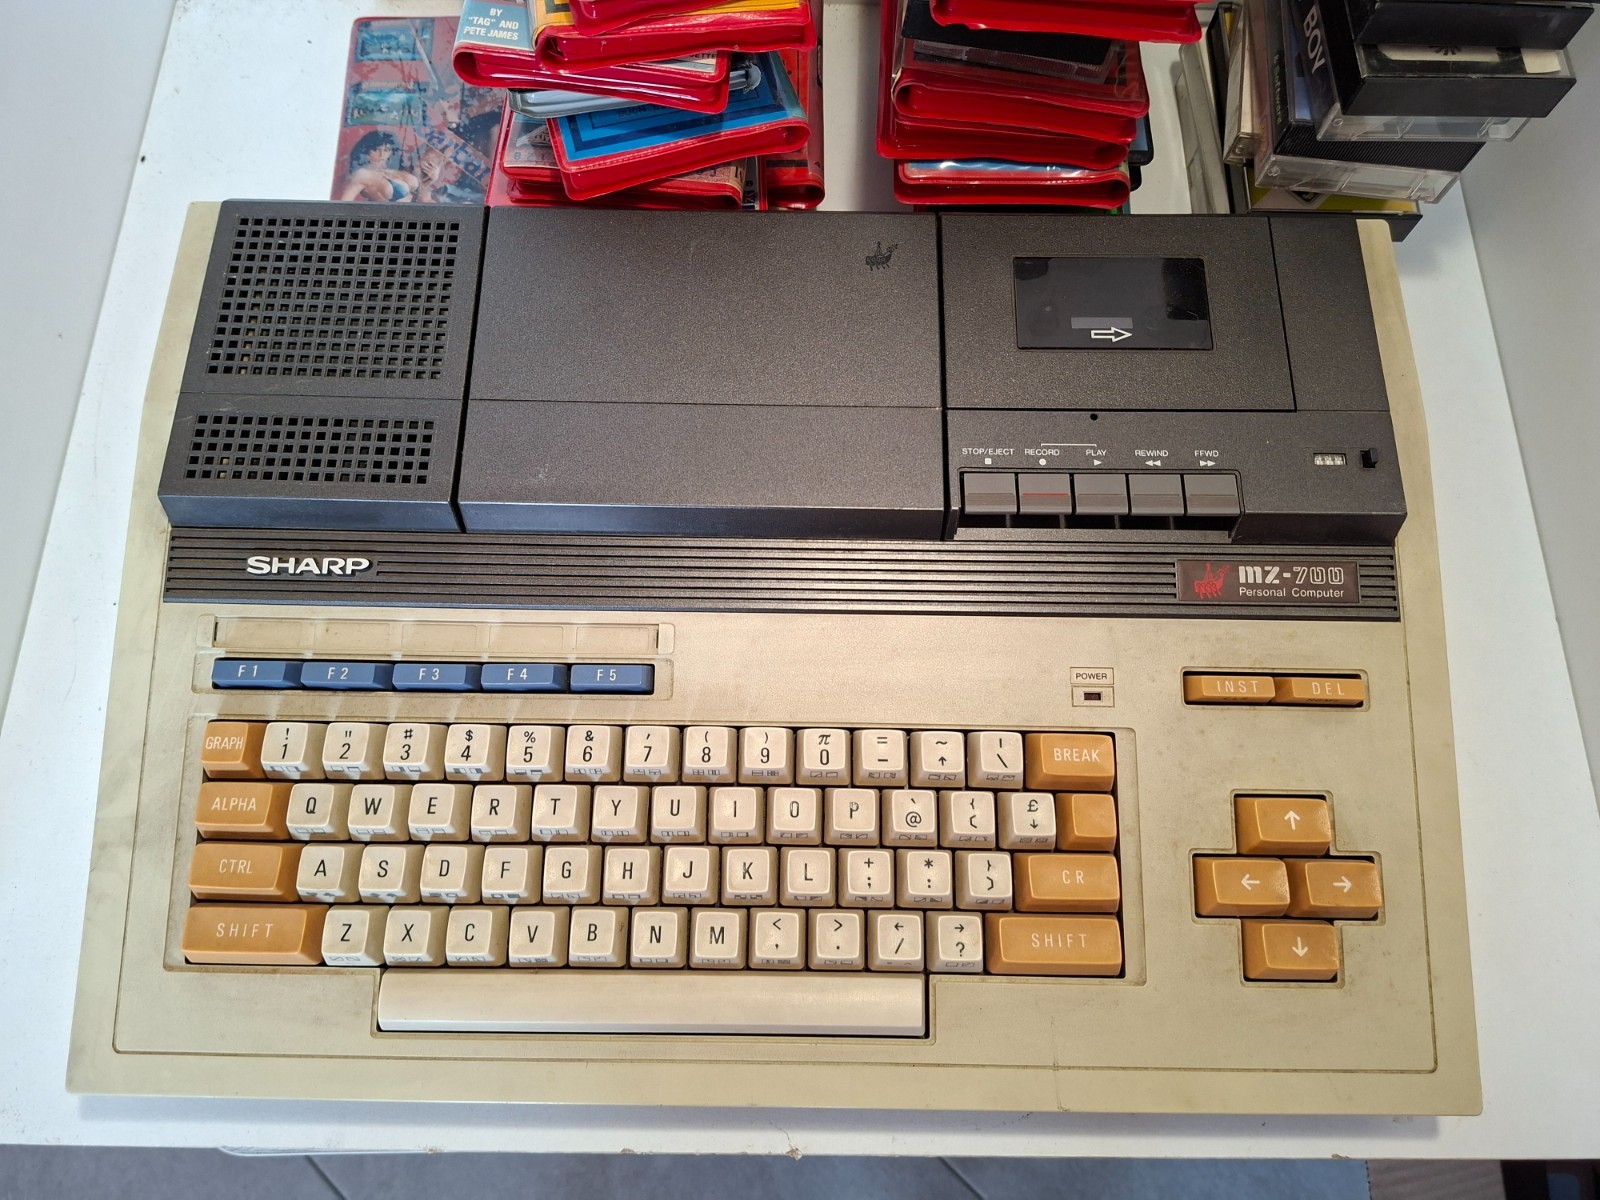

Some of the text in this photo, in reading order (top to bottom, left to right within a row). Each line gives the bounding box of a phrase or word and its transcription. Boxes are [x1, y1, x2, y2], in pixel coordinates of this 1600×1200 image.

[490, 8, 503, 17] BY
[463, 26, 519, 40] PETE JAMES
[499, 20, 519, 30] AND
[1303, 4, 1325, 75] BOY
[247, 555, 371, 575] SHARP
[1240, 587, 1344, 598] Personal Computer
[1075, 672, 1108, 680] POWER
[1217, 681, 1259, 693] INST
[1312, 682, 1345, 695] DEL
[404, 729, 413, 739] #
[465, 730, 473, 742] $
[524, 731, 536, 743] %
[585, 730, 594, 741] &
[818, 734, 831, 745] π
[206, 736, 243, 750] GRAPH
[340, 743, 351, 759] 2
[282, 744, 288, 759] 1
[400, 744, 411, 760] 3
[461, 745, 471, 761] 4
[523, 747, 533, 762] 5
[583, 746, 593, 762] 6
[643, 746, 652, 762] 7
[701, 747, 711, 762] 8
[761, 748, 770, 763] 9
[820, 749, 829, 765] 0
[1054, 748, 1100, 762] BREAK
[997, 753, 1008, 768] \
[212, 797, 257, 811] ALPHA
[306, 797, 316, 814] Q
[365, 797, 382, 815] W
[427, 797, 438, 814] E
[489, 799, 499, 815] R
[551, 799, 560, 815] T
[611, 799, 622, 816] Y
[670, 799, 680, 816] U
[733, 801, 737, 817] I
[790, 801, 799, 818] O
[850, 801, 859, 819] P
[1027, 799, 1038, 812] £
[905, 812, 922, 827] @
[219, 859, 253, 874] CTRL
[314, 860, 327, 876] A
[377, 860, 389, 877] S
[439, 860, 450, 877] D
[500, 861, 511, 878] F
[562, 861, 571, 879] G
[623, 862, 633, 879] H
[683, 861, 693, 878] J
[742, 862, 753, 880] K
[864, 858, 874, 868] +
[804, 863, 813, 881] L
[217, 923, 274, 938] SHIFT
[340, 924, 352, 941] Z
[465, 924, 475, 941] C
[588, 924, 597, 941] B
[773, 919, 781, 930] <
[834, 919, 843, 931] >
[401, 924, 414, 942] X
[528, 925, 538, 943] V
[650, 926, 662, 943] N
[710, 926, 725, 944] M
[1032, 933, 1088, 948] SHIFT
[895, 938, 904, 954] /
[956, 942, 965, 957] ?
